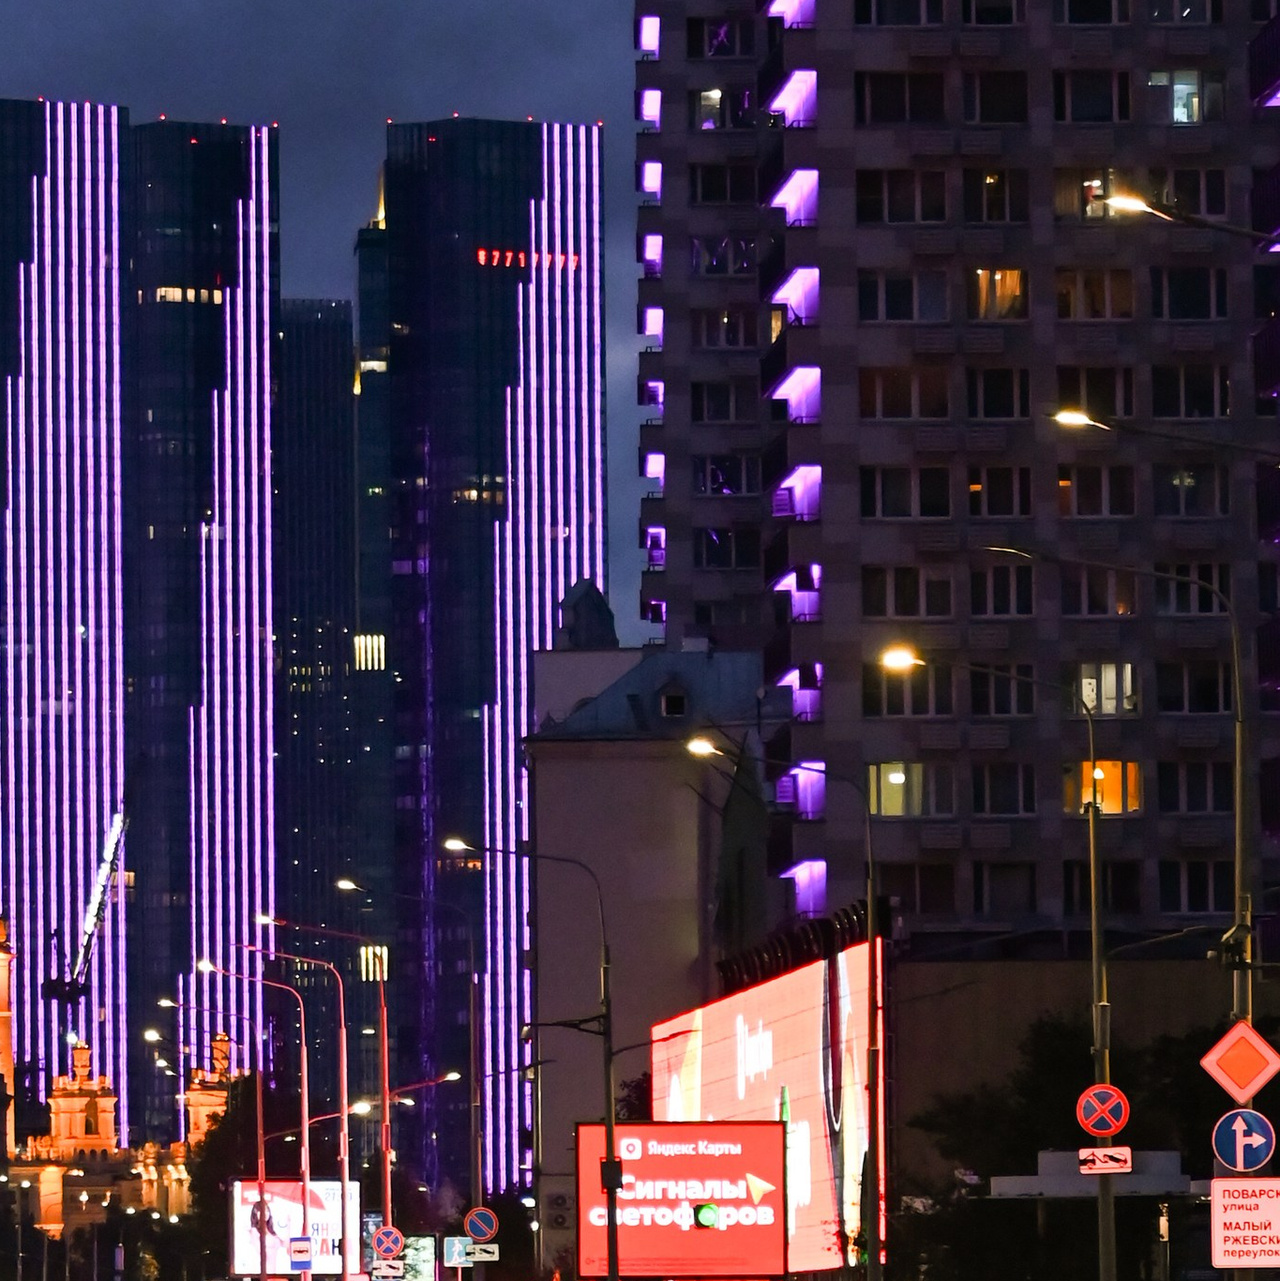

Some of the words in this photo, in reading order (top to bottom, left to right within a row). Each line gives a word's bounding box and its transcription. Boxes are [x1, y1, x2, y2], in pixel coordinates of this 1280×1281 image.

[647, 1141, 696, 1157] Яндекс
[698, 1141, 742, 1157] Карты
[616, 1174, 747, 1200] Сигналы
[1222, 1203, 1259, 1213] улица
[1223, 1220, 1272, 1231] МАЛЫЙ
[1223, 1249, 1280, 1258] переулок
